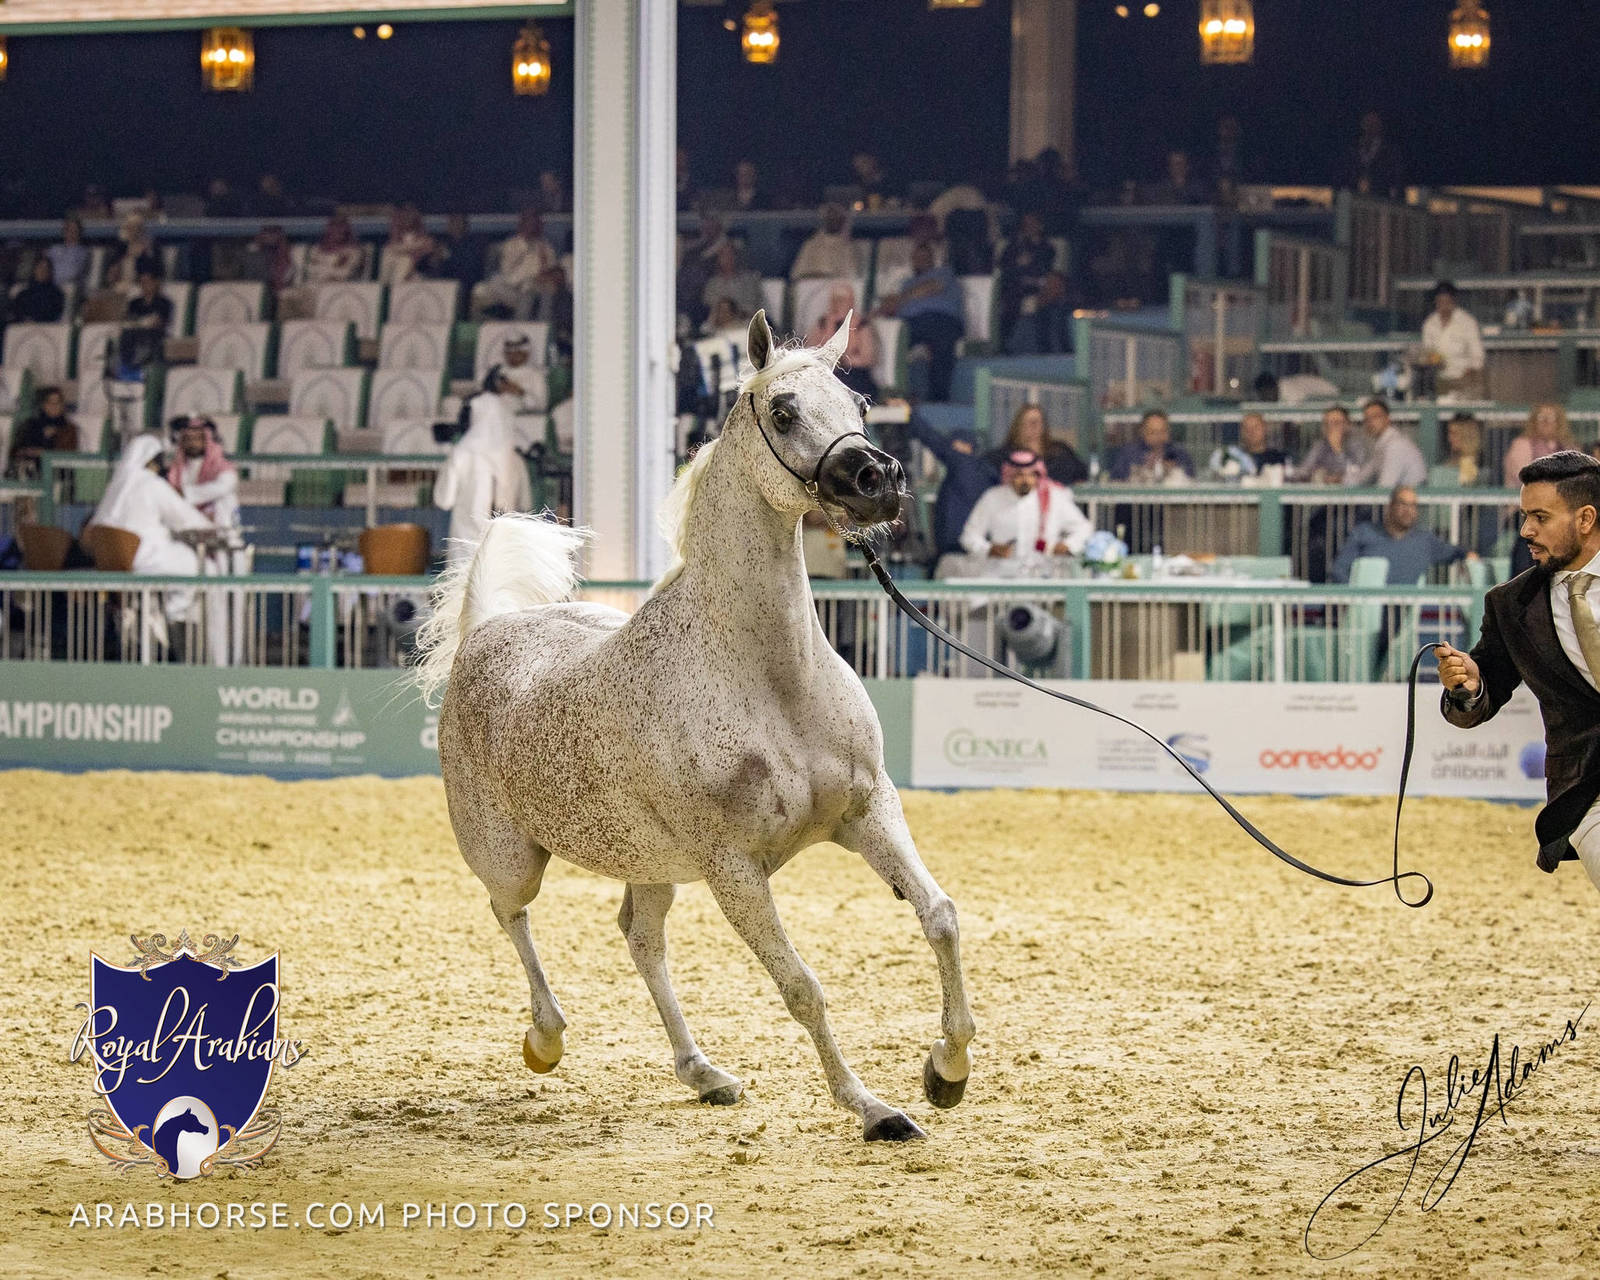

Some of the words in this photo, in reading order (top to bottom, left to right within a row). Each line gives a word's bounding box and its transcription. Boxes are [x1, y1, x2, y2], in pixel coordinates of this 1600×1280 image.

[217, 686, 320, 710] WORLD
[215, 727, 366, 749] CHAMPIONSHIP
[1259, 744, 1381, 770] ooredoo
